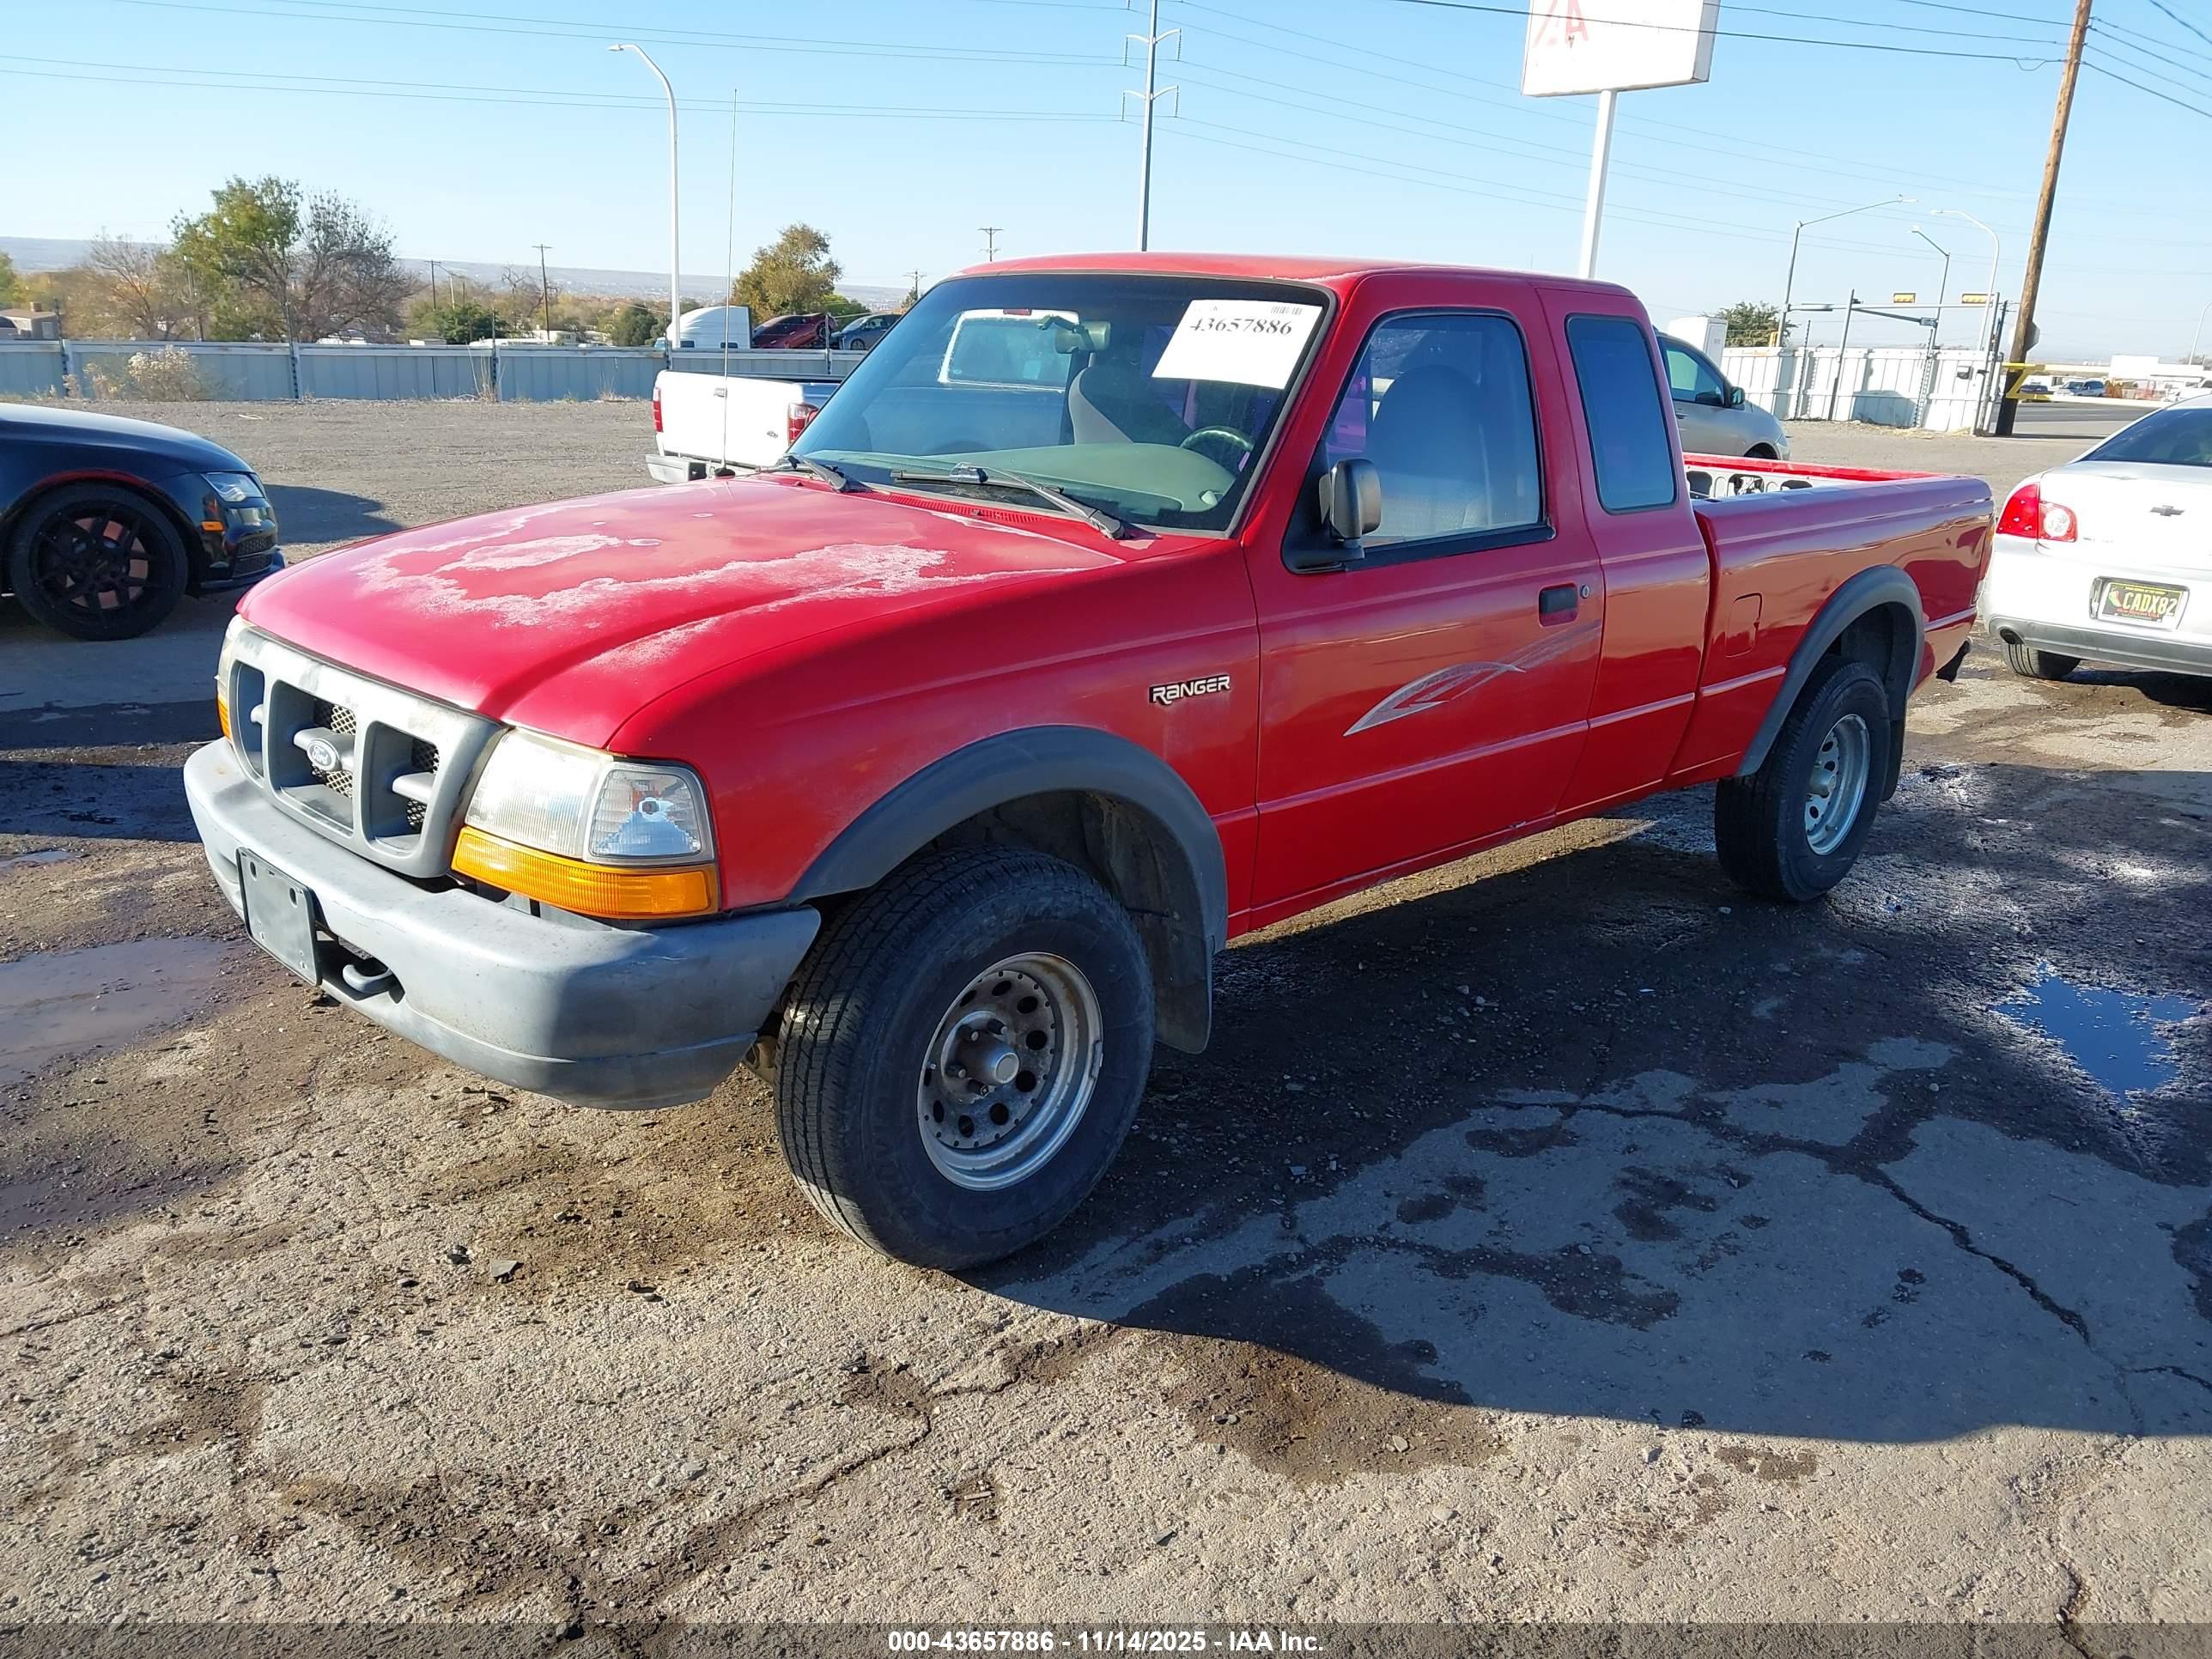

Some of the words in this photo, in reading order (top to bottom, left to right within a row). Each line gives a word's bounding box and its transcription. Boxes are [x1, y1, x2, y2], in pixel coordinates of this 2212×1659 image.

[1190, 318, 1292, 336] 43657886
[2123, 592, 2179, 616] CADX82
[1149, 674, 1231, 705] RANGER
